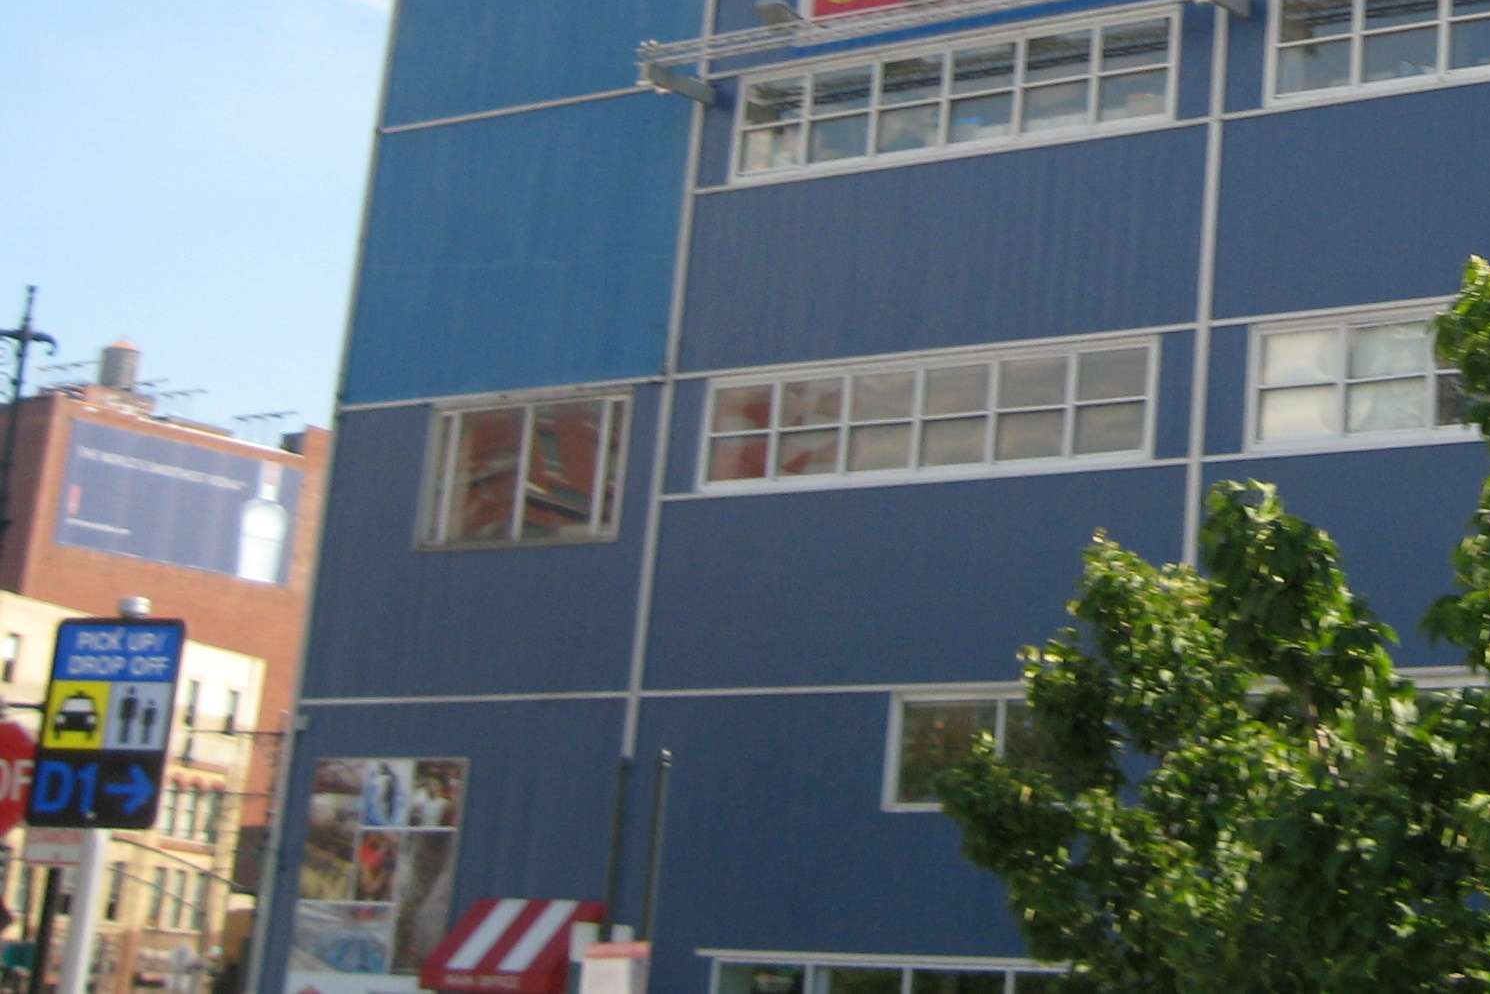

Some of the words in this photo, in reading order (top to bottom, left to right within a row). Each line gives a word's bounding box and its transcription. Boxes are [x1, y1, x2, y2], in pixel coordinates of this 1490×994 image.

[67, 655, 126, 676] DROP
[128, 656, 170, 675] OFF
[33, 759, 98, 815] D1
